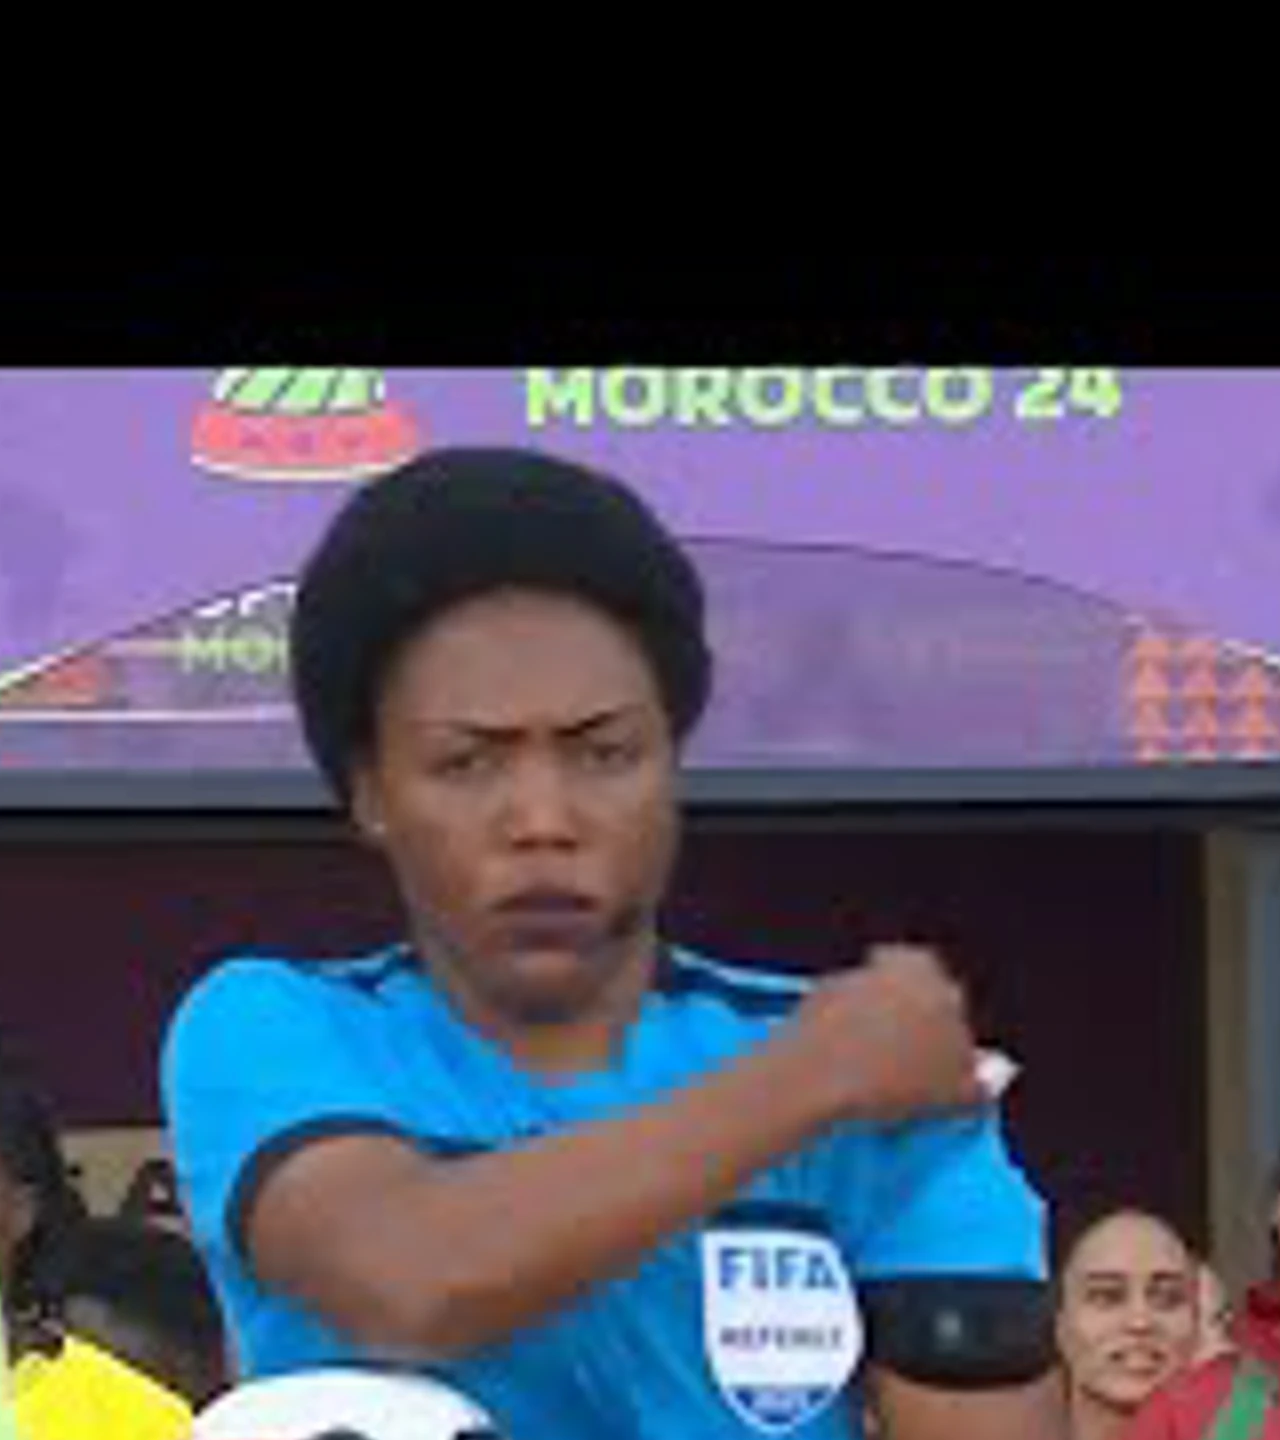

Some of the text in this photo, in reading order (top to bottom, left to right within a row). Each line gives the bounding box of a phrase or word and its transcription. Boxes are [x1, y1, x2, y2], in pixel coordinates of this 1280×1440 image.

[524, 367, 1122, 427] MOROCCO 24
[719, 1247, 840, 1291] FIFA
